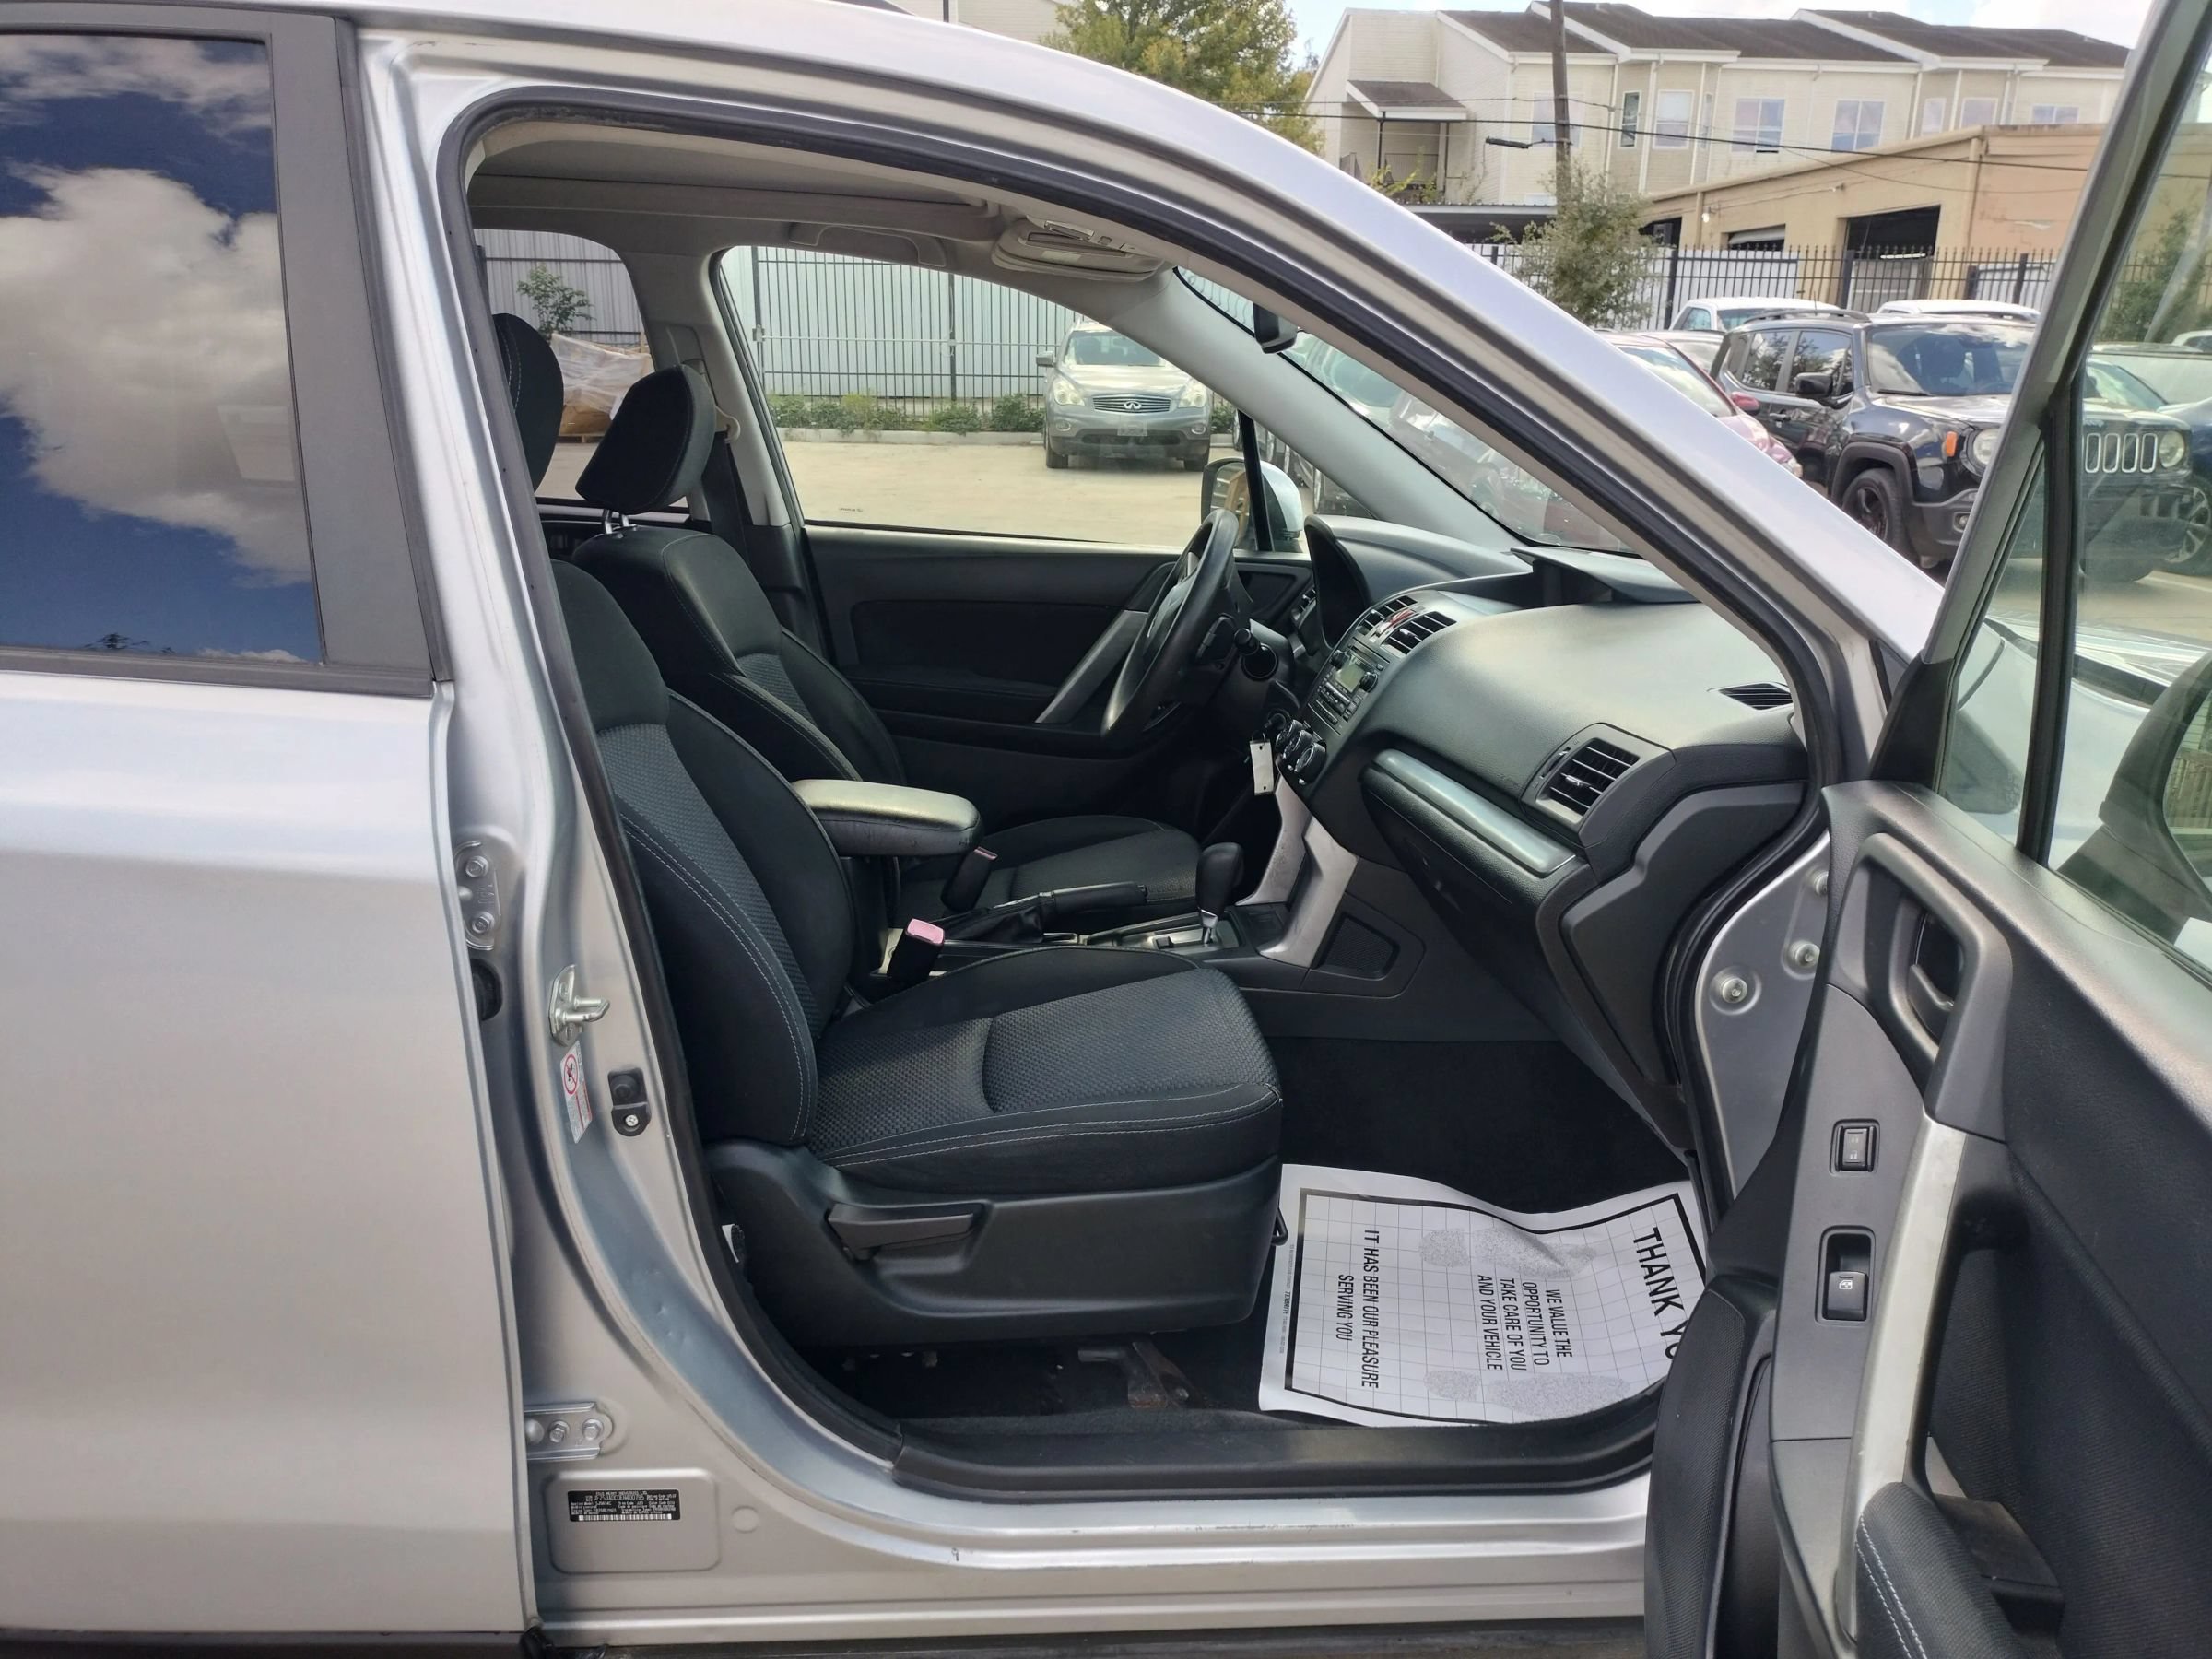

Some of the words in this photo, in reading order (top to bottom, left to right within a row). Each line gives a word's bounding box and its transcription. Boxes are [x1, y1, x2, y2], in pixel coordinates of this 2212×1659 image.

[1364, 1230, 1379, 1244] IT
[1363, 1248, 1379, 1272] HAS
[1633, 1227, 1685, 1317] THANK
[1336, 1274, 1354, 1319] SERVING
[1362, 1276, 1379, 1302] BEEN
[1477, 1274, 1494, 1296] AND
[1500, 1278, 1517, 1301] TAKE
[1546, 1289, 1562, 1303] WE
[1362, 1305, 1379, 1327] OUR
[1480, 1299, 1498, 1324] YOUR
[1502, 1304, 1522, 1331] CARE
[1522, 1281, 1548, 1348] OPPORTUNITY
[1548, 1306, 1569, 1336] VALUE
[1335, 1322, 1353, 1341] YOU
[1506, 1334, 1524, 1347] OF
[1361, 1329, 1379, 1388] PLEASURE
[1483, 1328, 1503, 1371] VEHICLE
[1533, 1350, 1550, 1365] TO
[1554, 1338, 1572, 1358] THE
[1509, 1349, 1527, 1371] YOU
